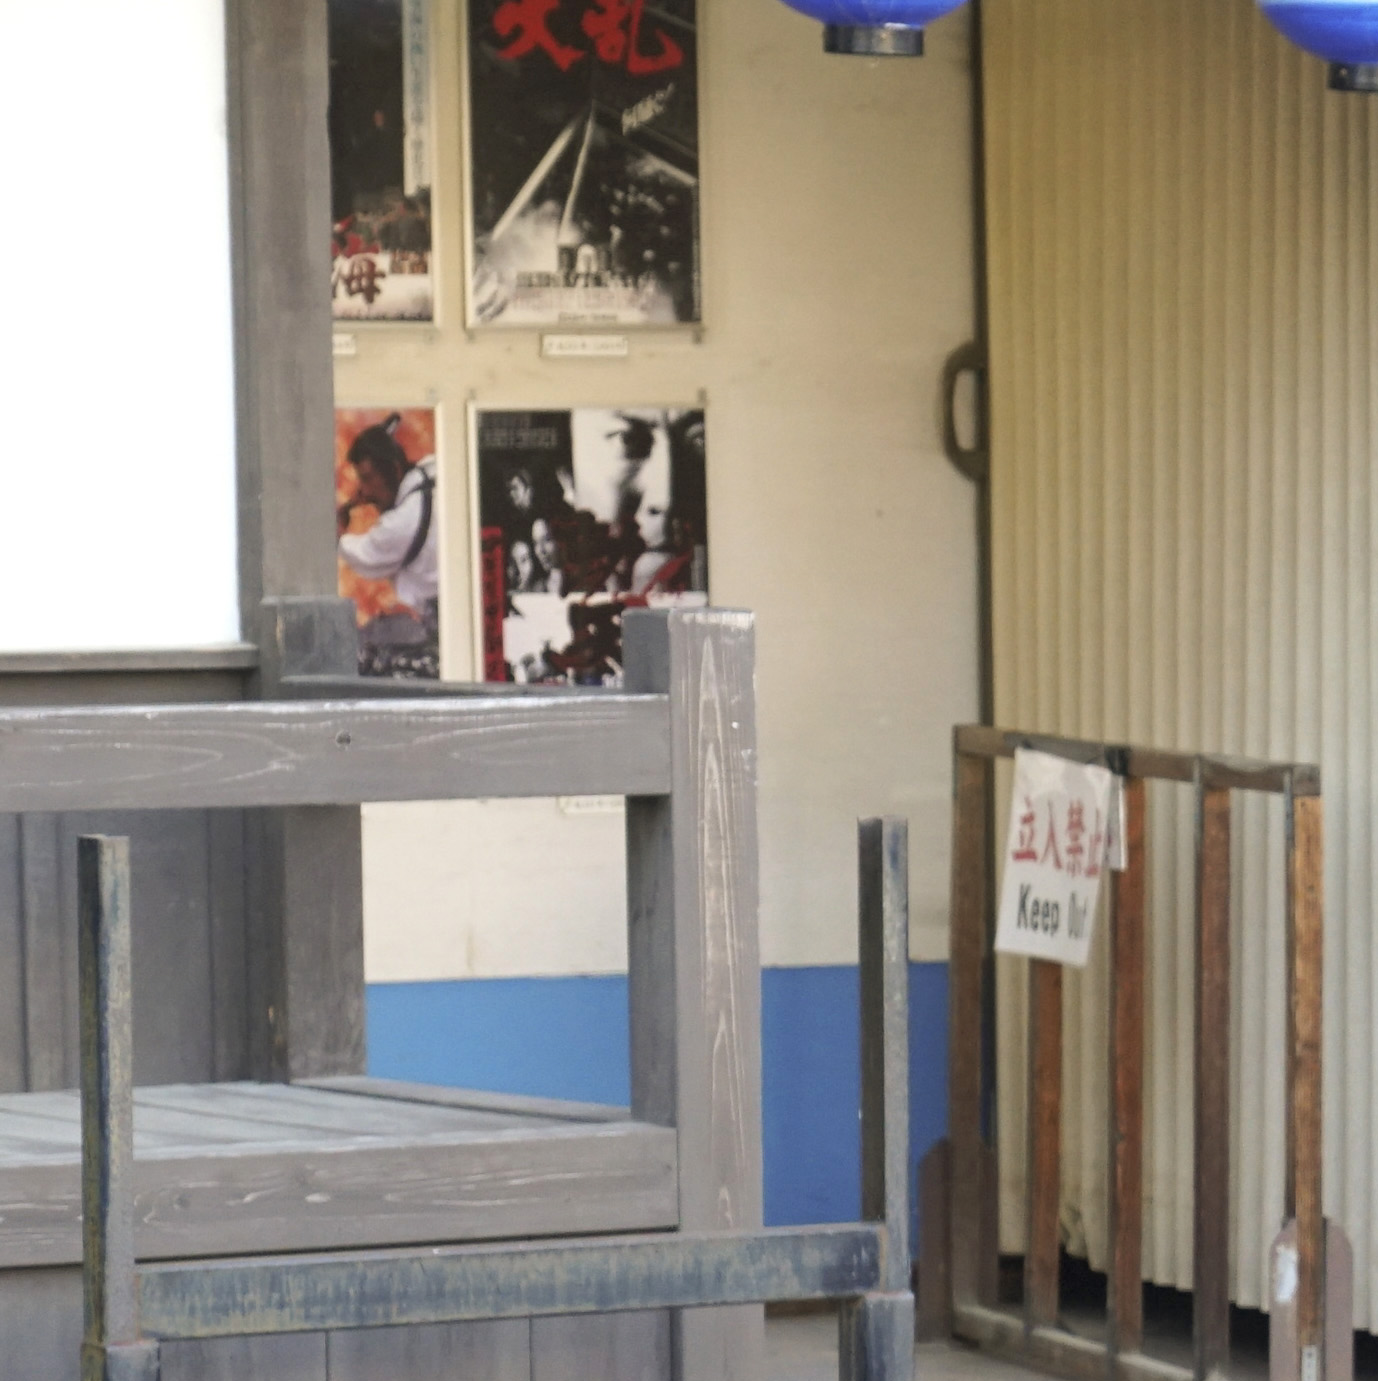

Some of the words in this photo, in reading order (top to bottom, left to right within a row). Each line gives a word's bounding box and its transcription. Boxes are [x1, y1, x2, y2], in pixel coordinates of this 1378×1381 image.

[1012, 796, 1102, 878] 立入禁止
[1017, 884, 1060, 937] Keep
